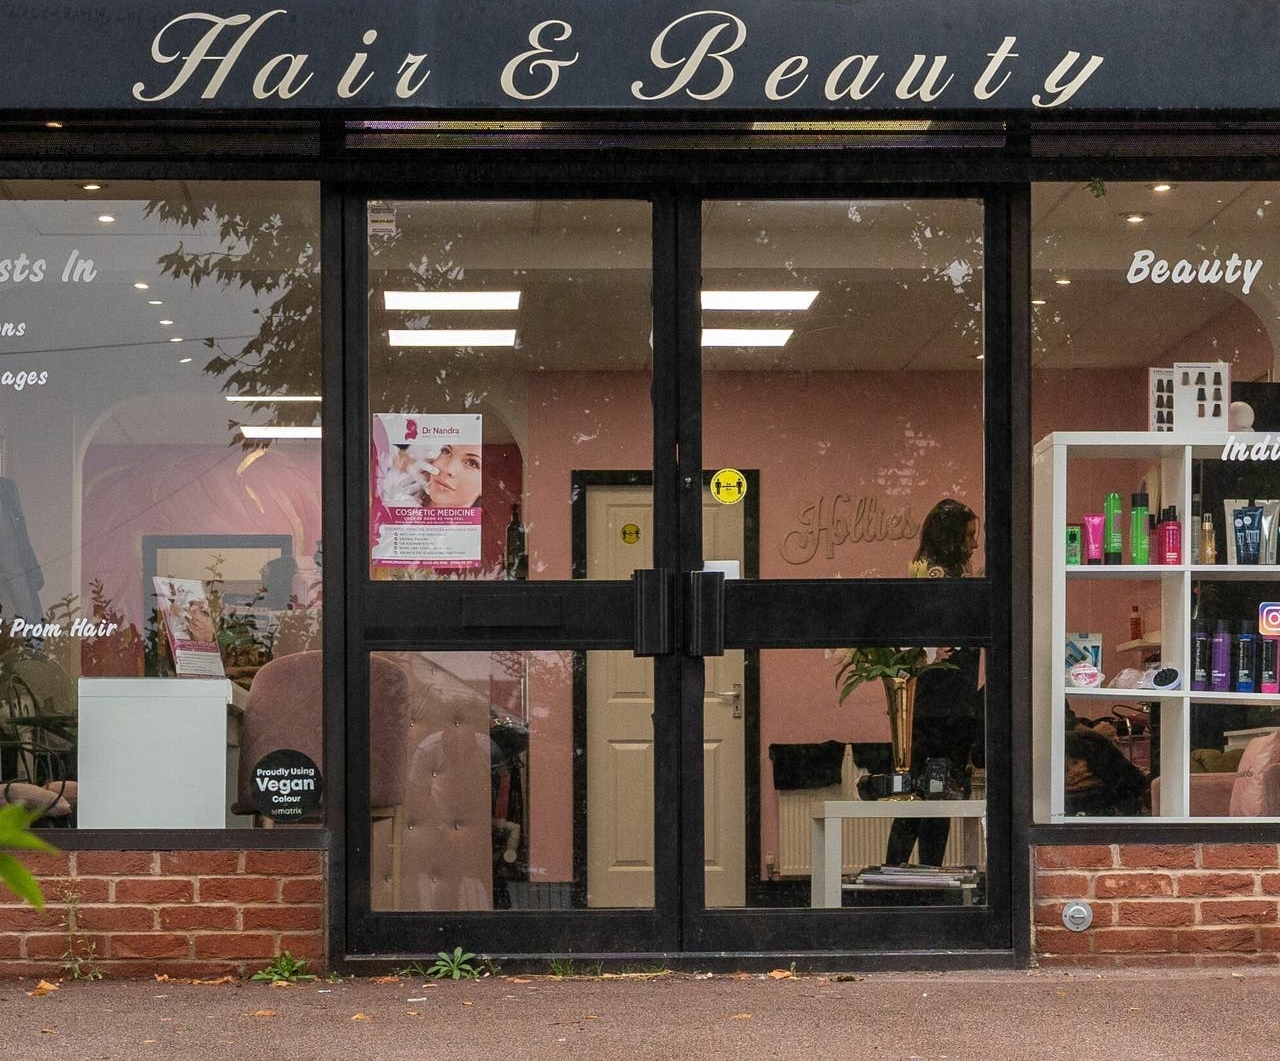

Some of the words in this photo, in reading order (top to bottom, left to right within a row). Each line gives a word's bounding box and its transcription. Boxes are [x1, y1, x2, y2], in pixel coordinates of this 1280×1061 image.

[132, 10, 431, 102] Hair
[500, 19, 580, 100] &
[631, 10, 1105, 109] Beauty
[61, 250, 98, 283] In
[1126, 250, 1264, 294] Beauty
[433, 426, 460, 435] Nandra
[395, 508, 436, 516] COSMETIC
[437, 508, 476, 517] MEDICINE
[10, 618, 64, 639] Prom
[70, 618, 117, 639] Hair
[256, 768, 290, 777] Proudly
[291, 767, 315, 776] Using
[255, 777, 315, 795] Vegan
[272, 795, 301, 803] Colour
